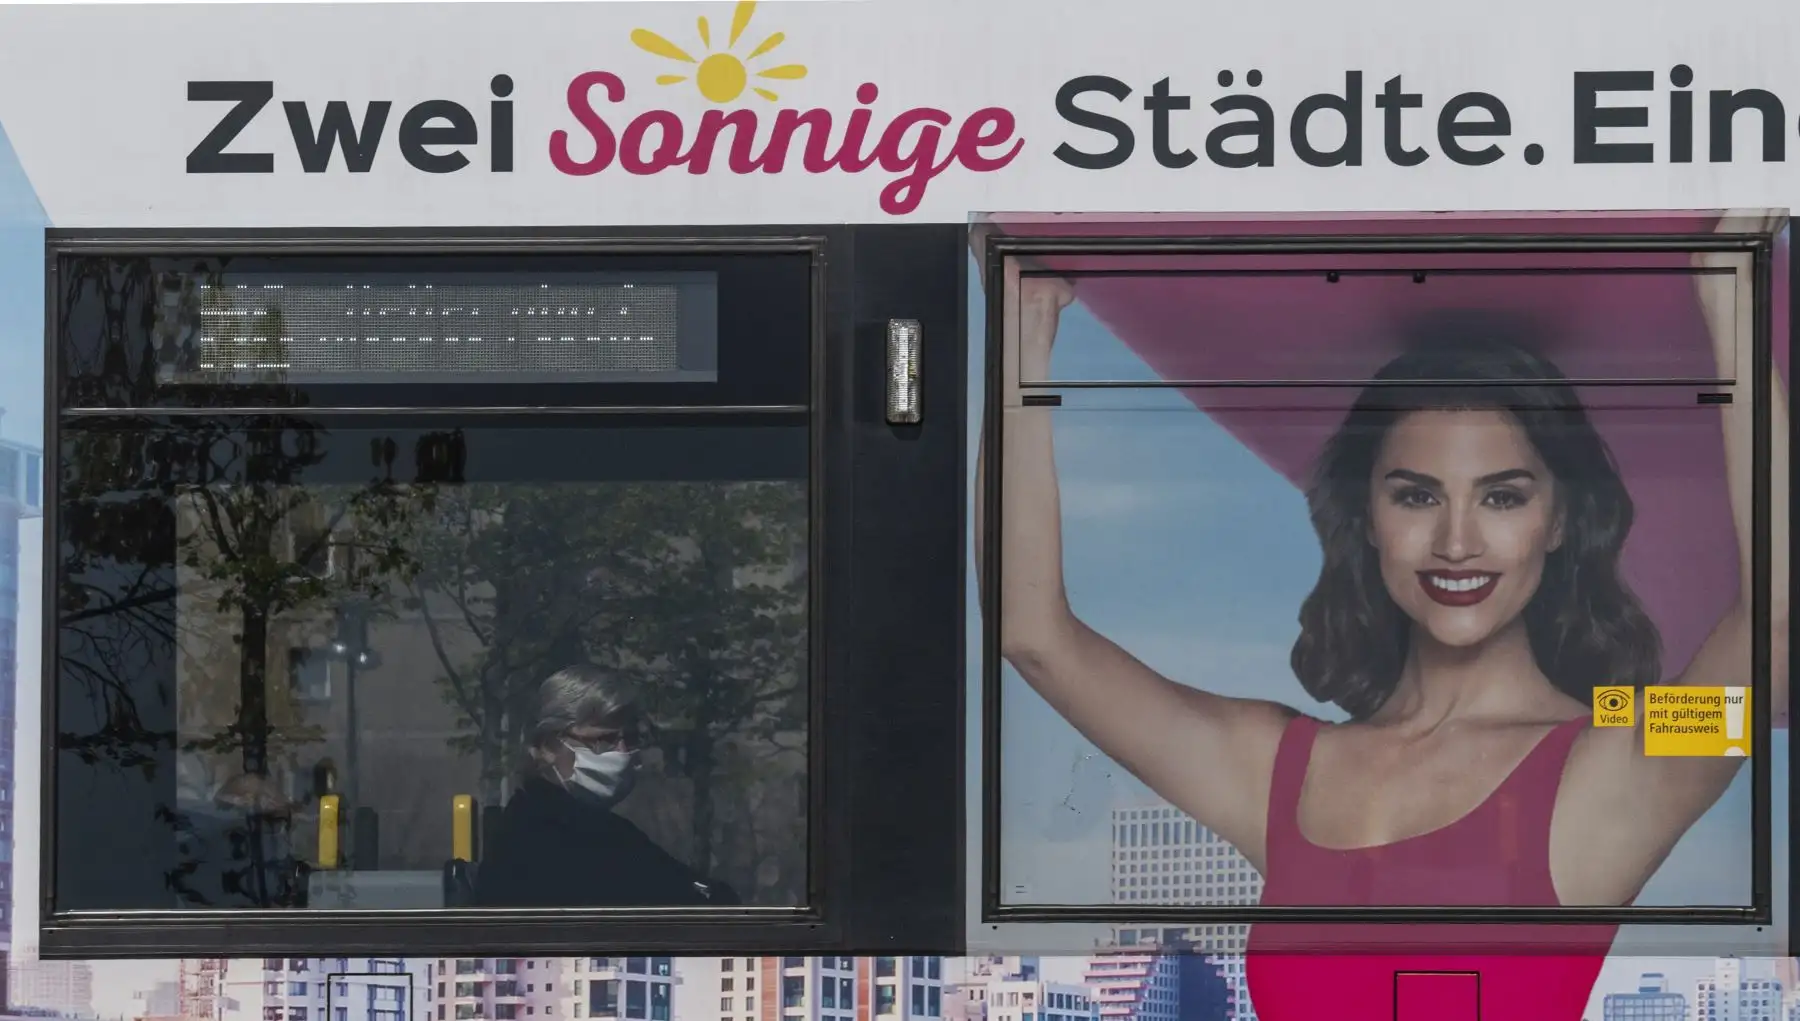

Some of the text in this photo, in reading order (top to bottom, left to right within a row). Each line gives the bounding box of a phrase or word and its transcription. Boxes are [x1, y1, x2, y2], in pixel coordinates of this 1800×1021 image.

[185, 64, 1800, 215] Zwei Sonnige Städte. Ein
[1649, 692, 1743, 707] Beförderung nur
[1600, 714, 1628, 724] Video
[1649, 708, 1722, 721] mit gültigem
[1649, 723, 1720, 734] Fahrausweis
